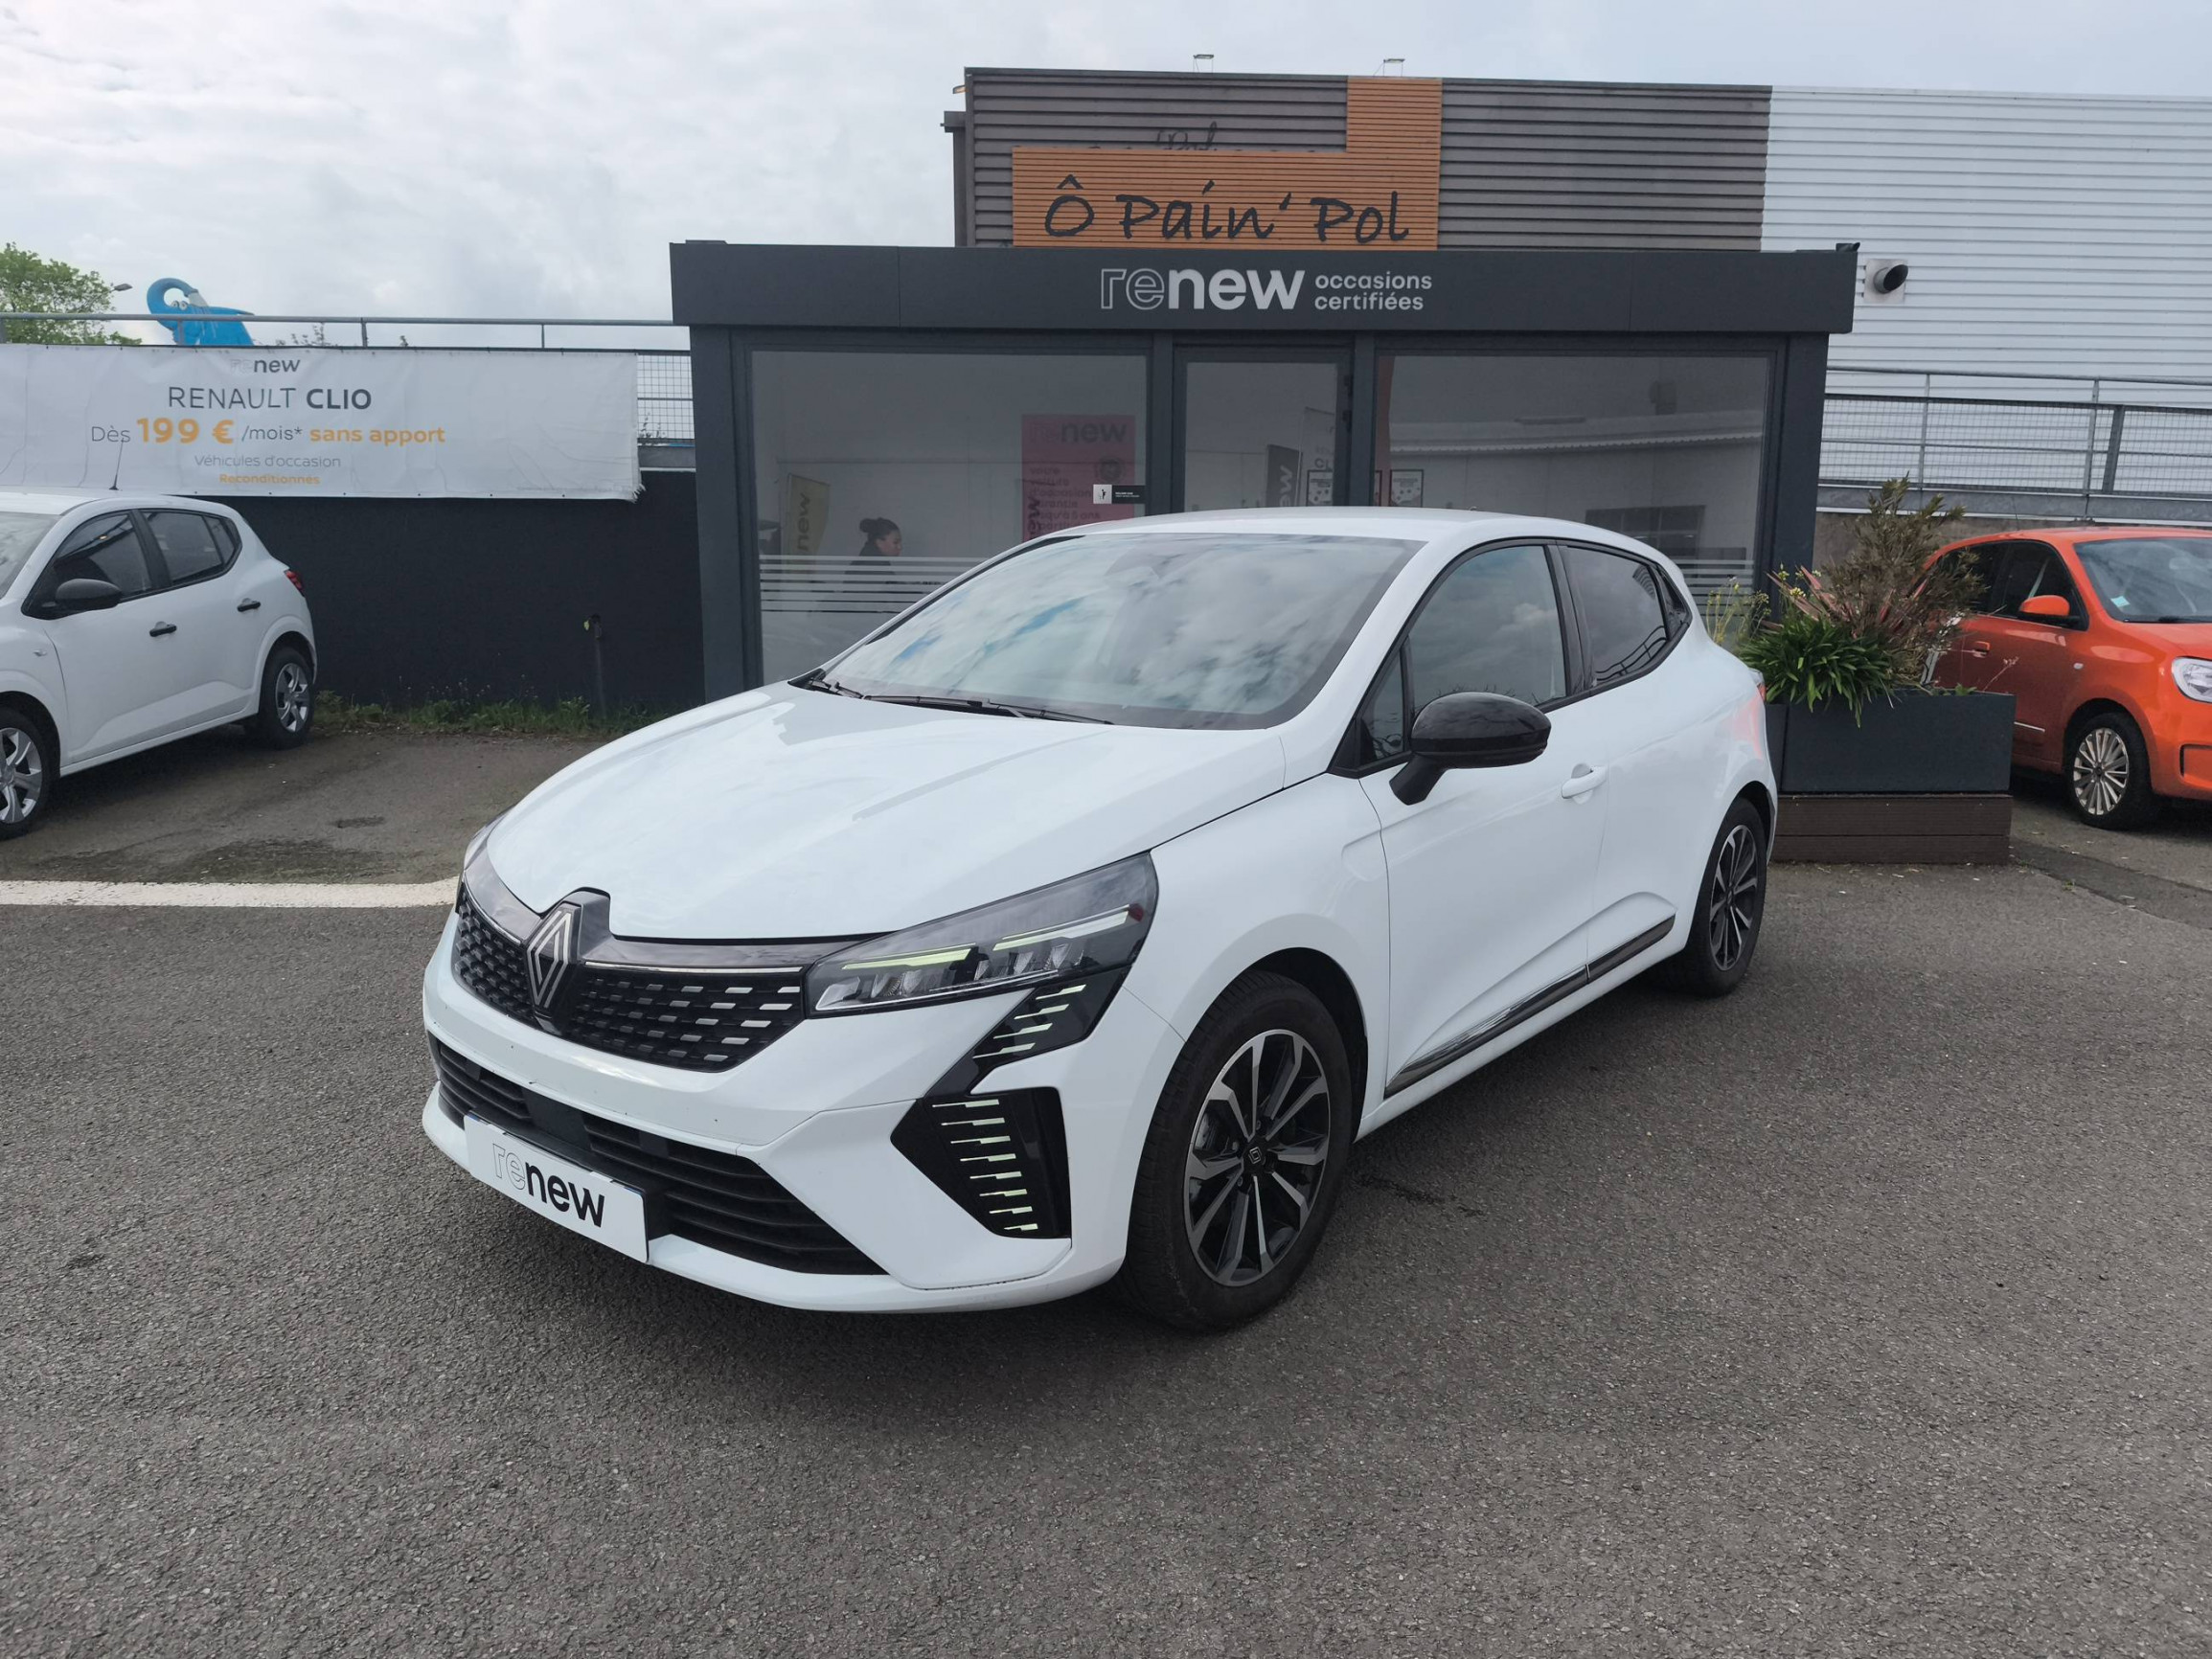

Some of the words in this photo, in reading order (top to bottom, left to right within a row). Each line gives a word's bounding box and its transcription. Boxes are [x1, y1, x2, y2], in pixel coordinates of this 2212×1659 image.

[1044, 173, 1094, 238] Ô
[1115, 179, 1292, 239] Pain'
[1310, 191, 1409, 243] Pol
[1100, 267, 1306, 311] renew
[1314, 270, 1432, 289] occasions
[1313, 290, 1425, 310] certifiées
[169, 386, 296, 410] RENAULT
[306, 388, 373, 410] CLIO
[91, 424, 131, 443] Dès
[136, 418, 199, 443] 199
[213, 420, 235, 444] €
[309, 429, 363, 443] sans
[370, 427, 446, 447] apport
[194, 455, 261, 467] Véhicules
[492, 1143, 605, 1228] renew
